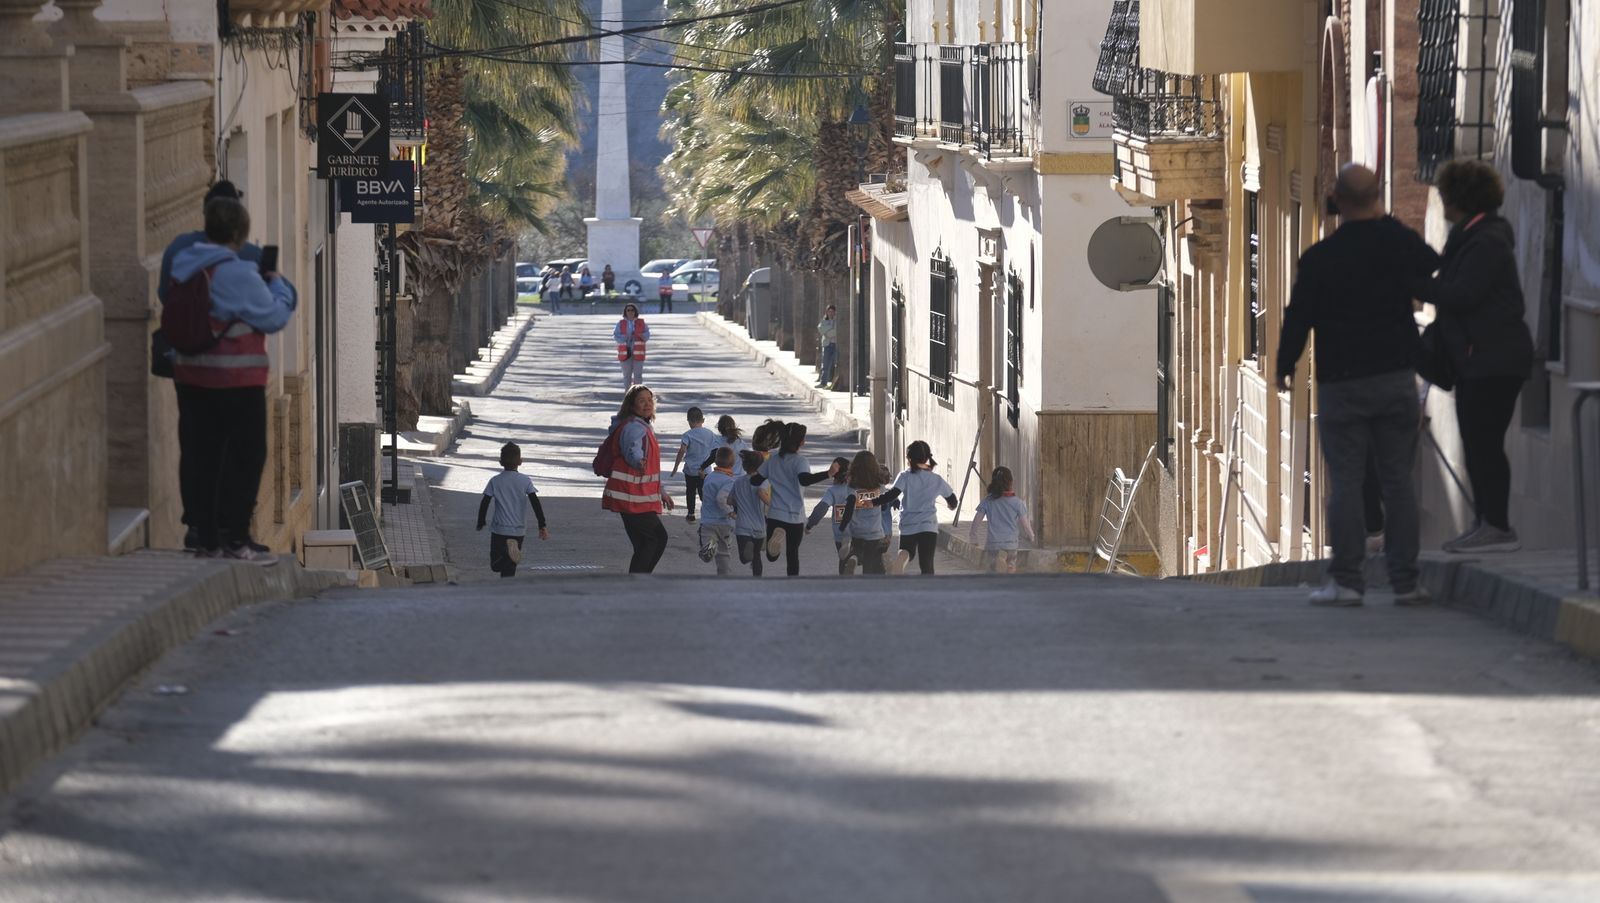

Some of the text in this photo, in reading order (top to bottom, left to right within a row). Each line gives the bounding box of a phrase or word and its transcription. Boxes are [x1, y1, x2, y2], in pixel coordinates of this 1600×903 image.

[327, 154, 380, 165] GABINETE
[328, 165, 378, 177] JURÍDICO
[356, 180, 406, 195] BBVA
